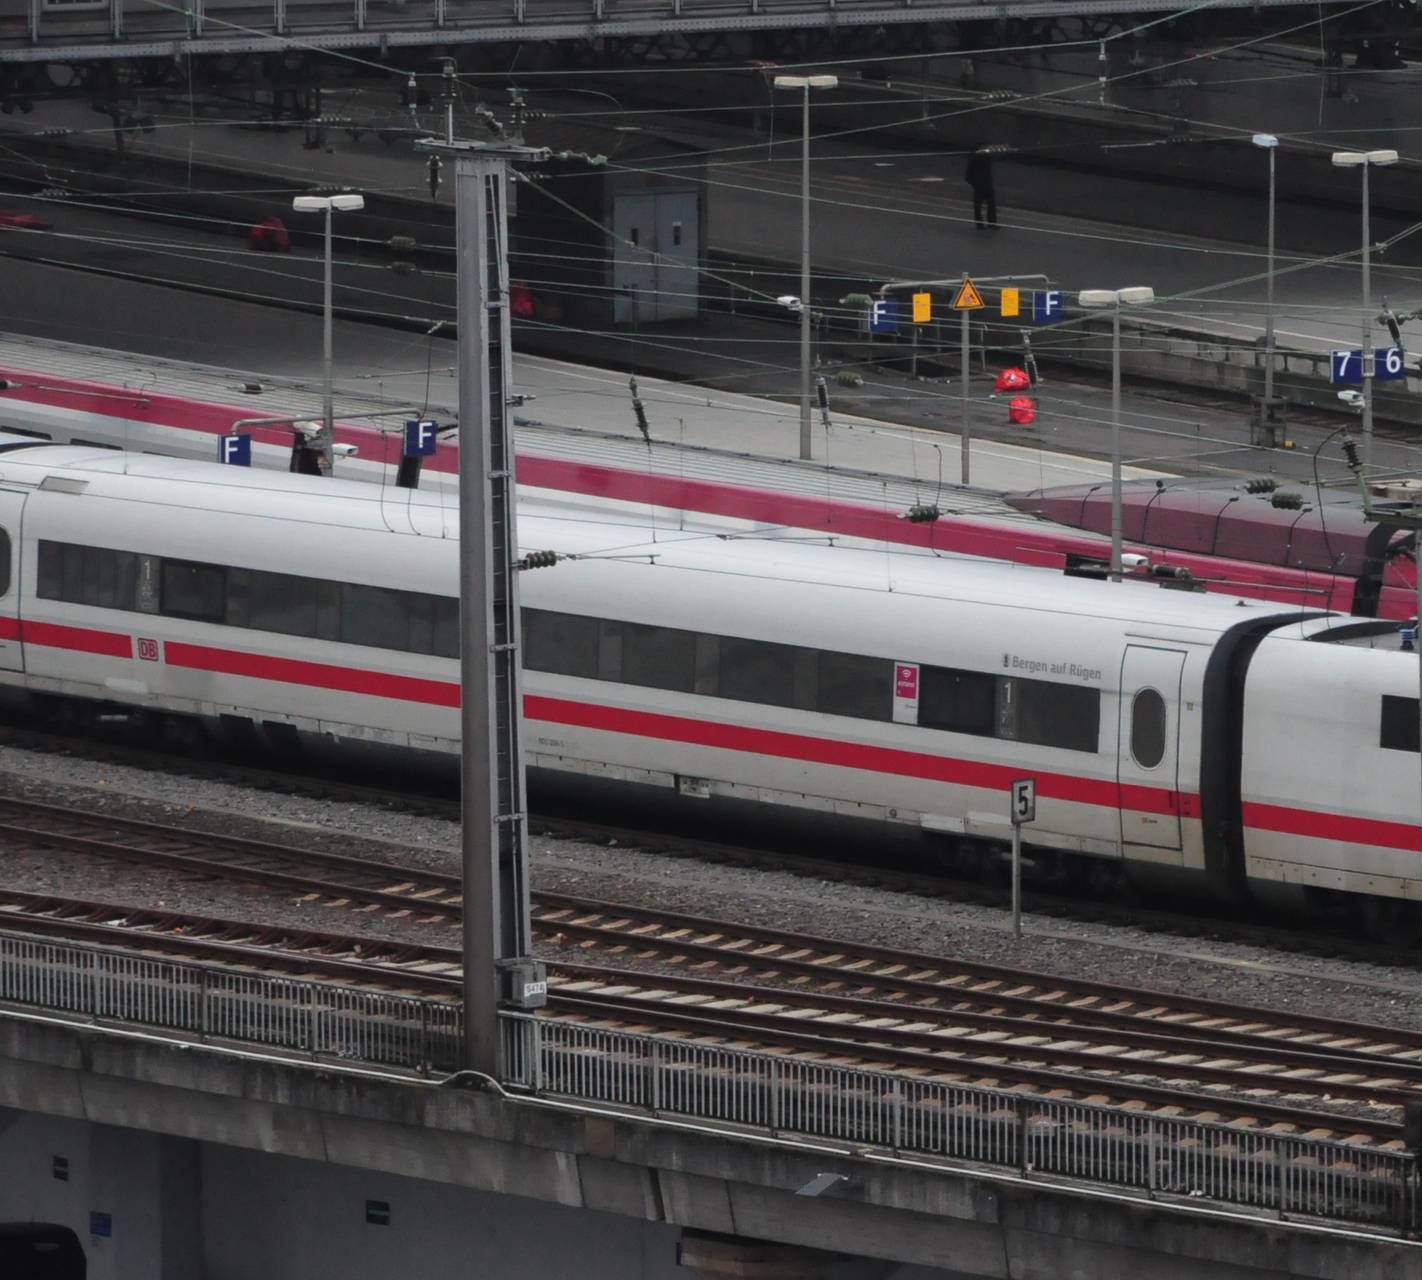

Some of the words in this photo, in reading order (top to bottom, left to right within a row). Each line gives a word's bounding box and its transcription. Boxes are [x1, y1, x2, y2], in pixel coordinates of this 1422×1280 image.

[873, 301, 887, 325] F
[1046, 291, 1059, 315] F
[1337, 351, 1351, 377] 7
[1386, 347, 1401, 374] 6
[418, 422, 433, 448] F
[224, 437, 239, 463] F
[144, 559, 151, 580] 1
[140, 640, 157, 659] DB
[1012, 656, 1047, 673] Bergen
[1050, 663, 1066, 674] auf
[1070, 664, 1101, 681] Rügen
[1004, 682, 1011, 703] 1
[1018, 785, 1028, 816] 5
